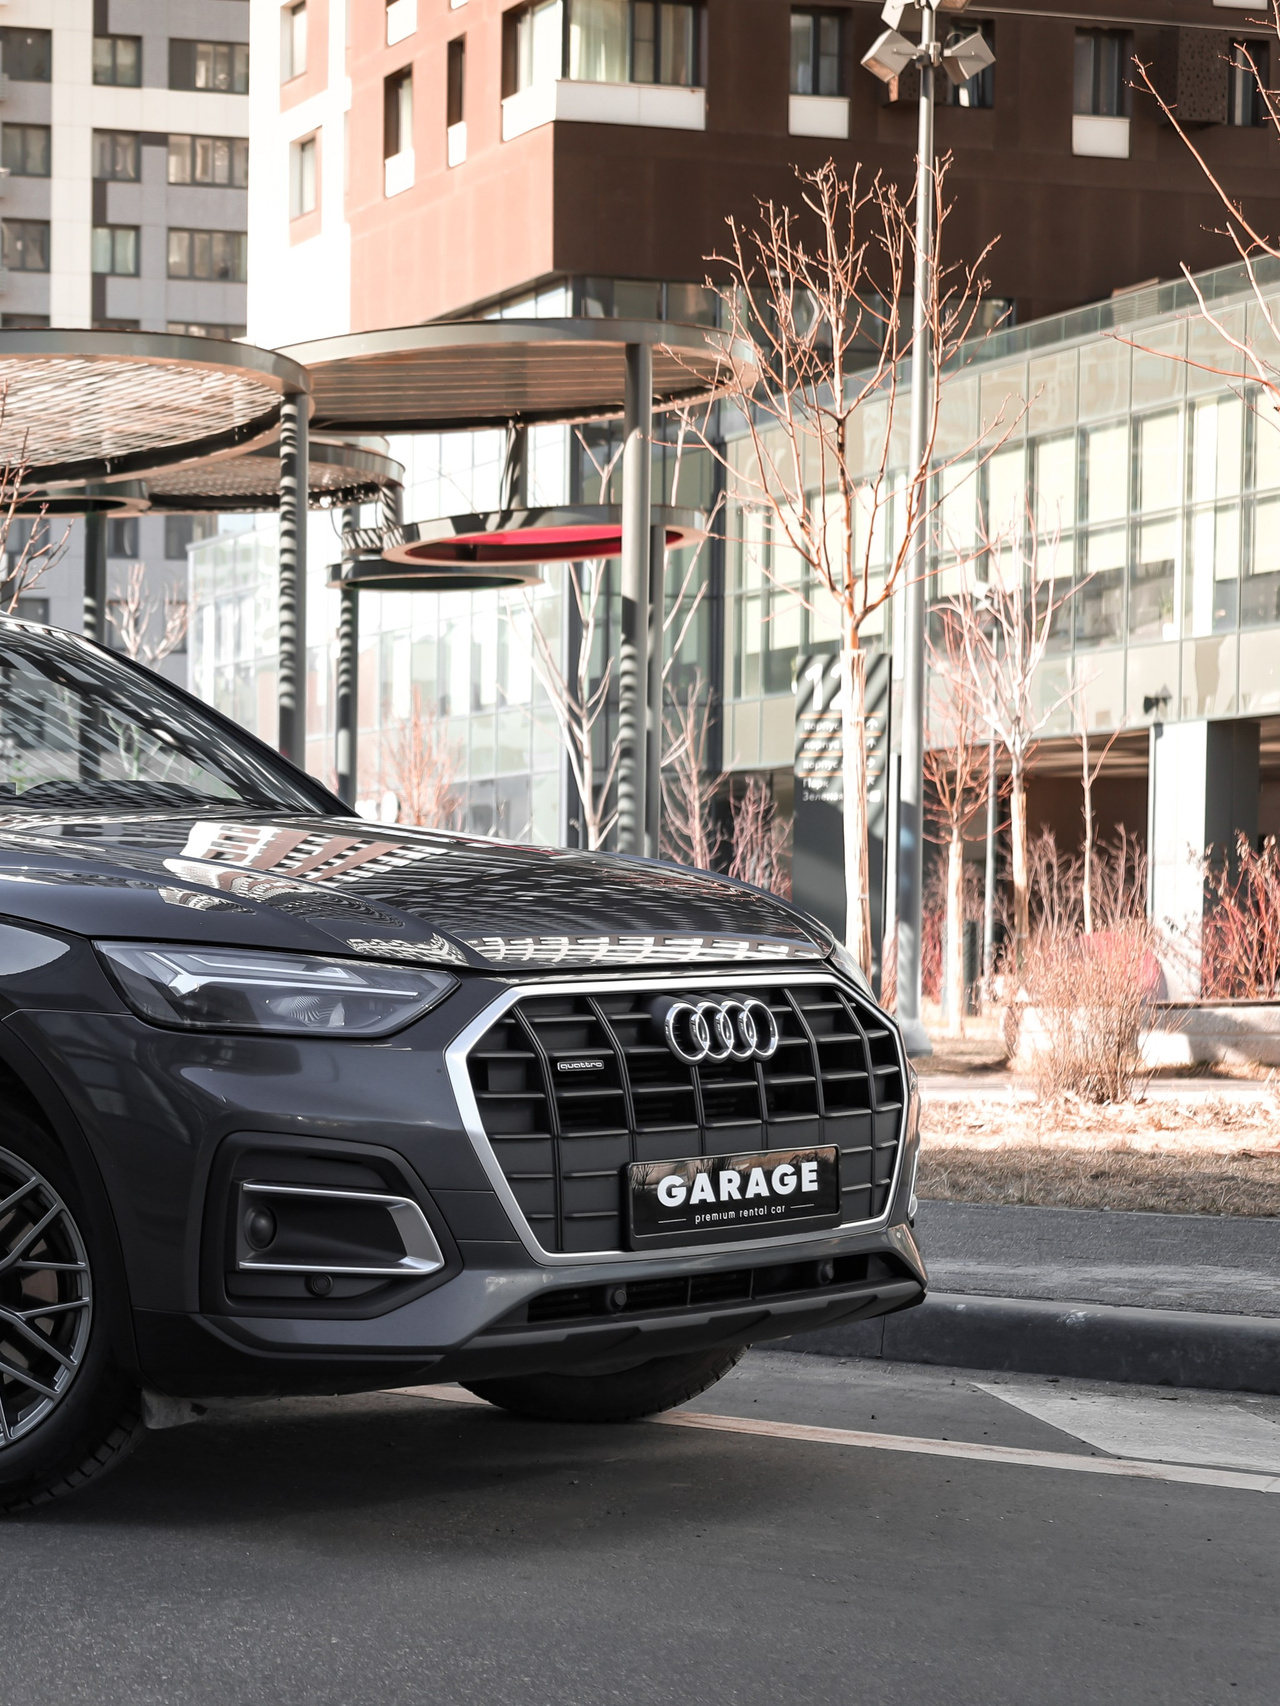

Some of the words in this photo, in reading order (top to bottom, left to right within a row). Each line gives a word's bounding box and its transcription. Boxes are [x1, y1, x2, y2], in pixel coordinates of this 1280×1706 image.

[560, 1062, 602, 1070] quattro
[657, 1161, 818, 1207] GARAGE
[695, 1211, 735, 1225] premium
[739, 1205, 767, 1217] rental
[770, 1205, 785, 1214] car
